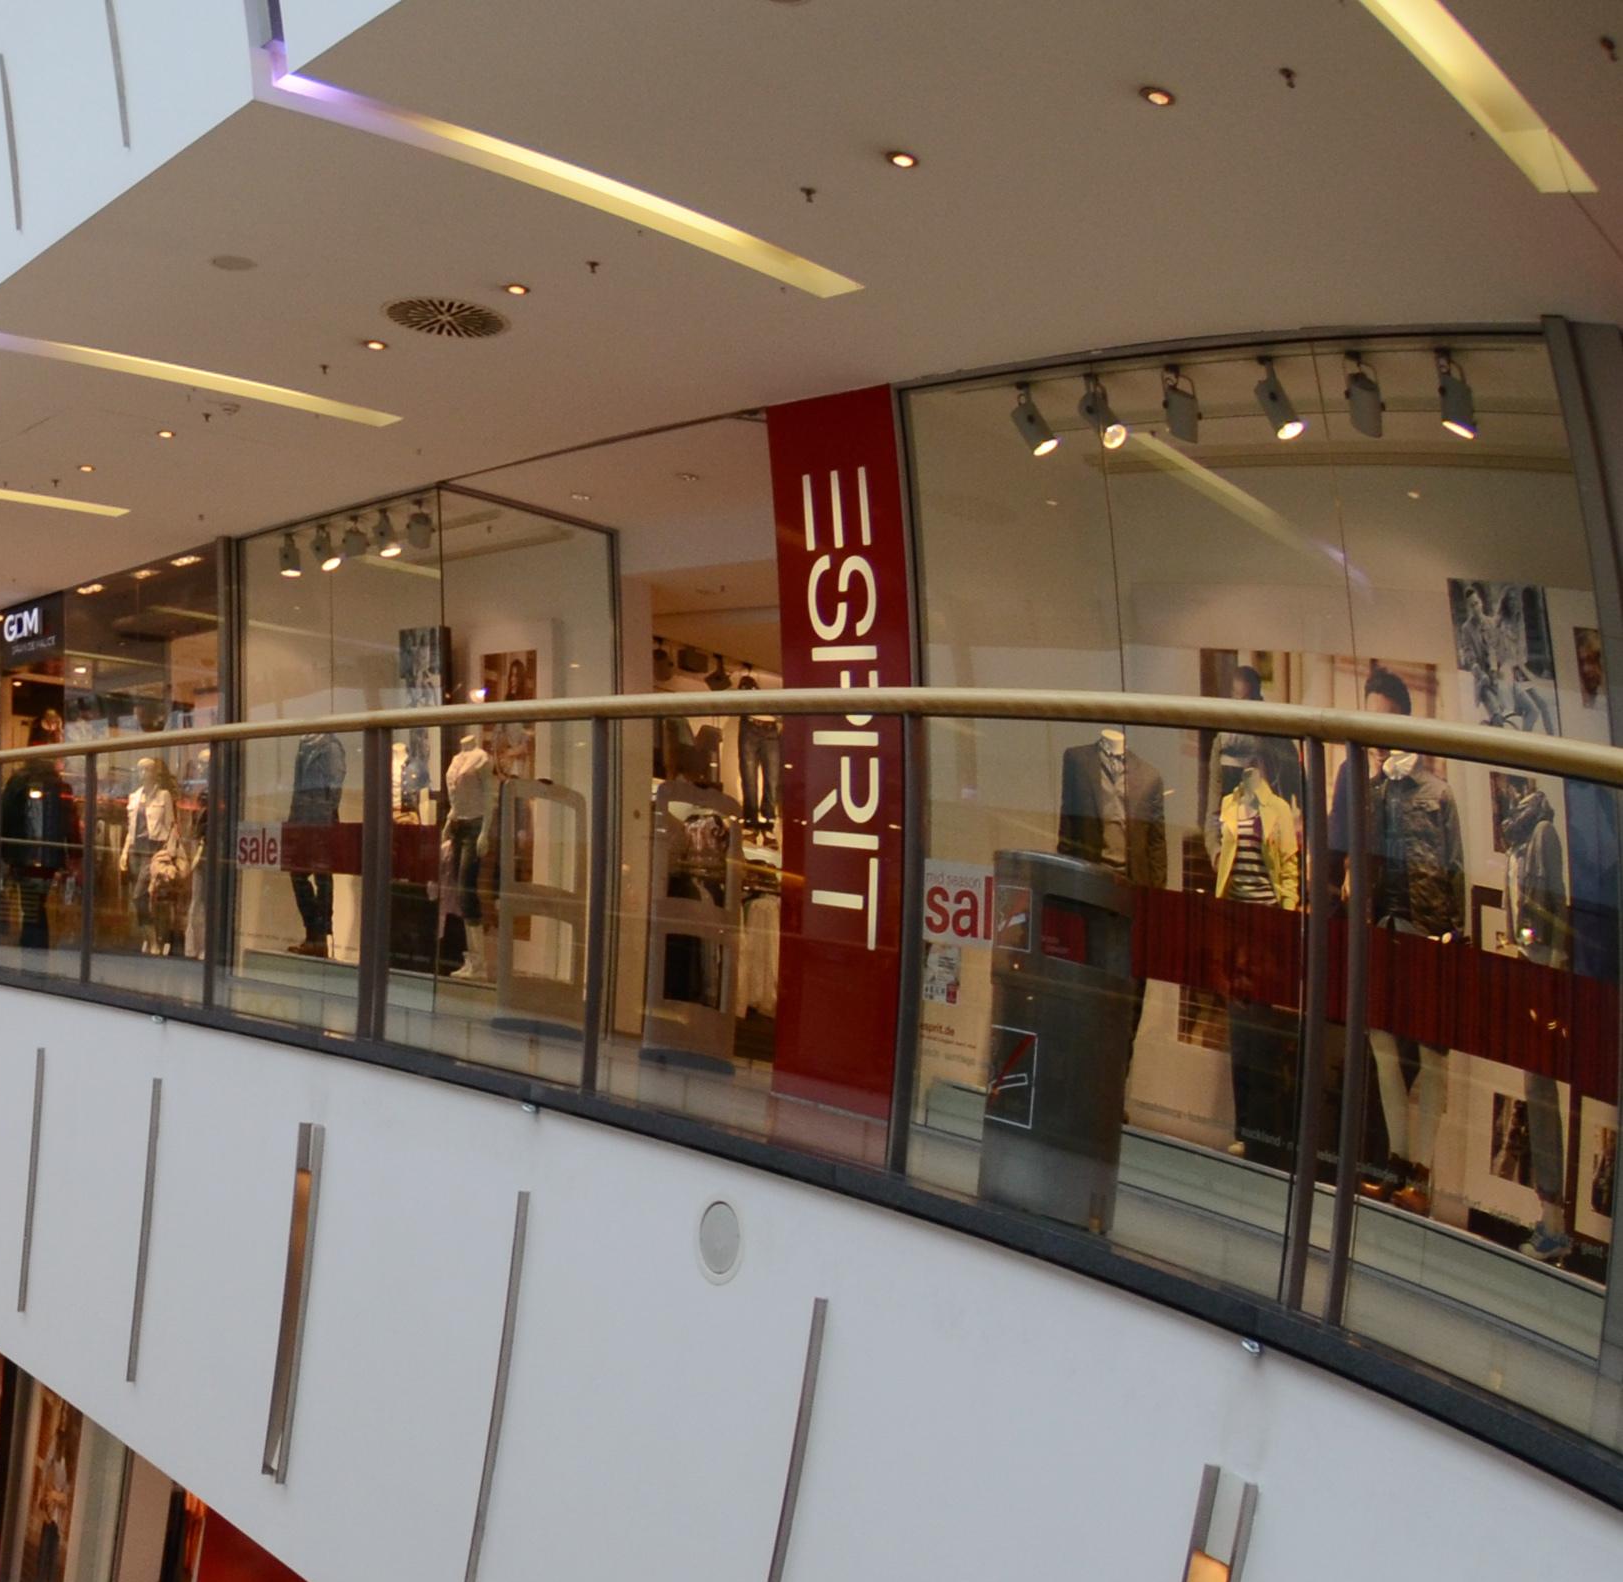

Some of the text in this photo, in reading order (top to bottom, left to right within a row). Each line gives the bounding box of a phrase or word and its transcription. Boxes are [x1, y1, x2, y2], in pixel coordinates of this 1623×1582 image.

[4, 608, 40, 642] GDM
[802, 466, 879, 951] ESPRIT
[238, 828, 278, 865] sale
[925, 886, 993, 940] sal
